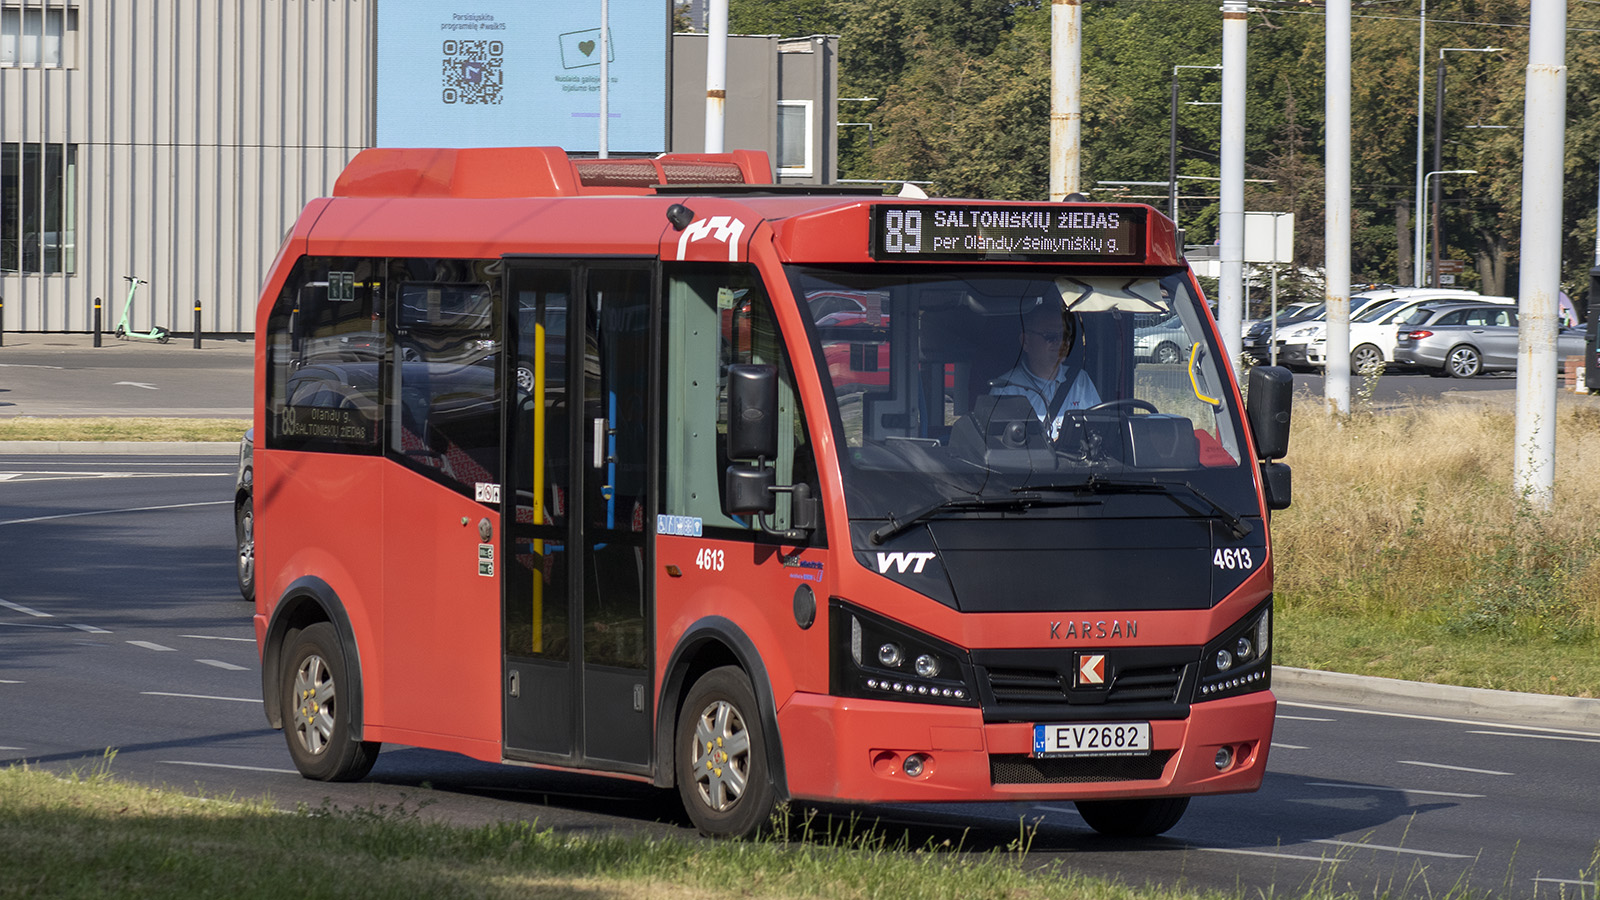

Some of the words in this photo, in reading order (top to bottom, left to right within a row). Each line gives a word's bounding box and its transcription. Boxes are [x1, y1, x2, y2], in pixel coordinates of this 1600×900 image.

[885, 209, 922, 253] 89
[1058, 212, 1120, 229] ŽIEDAS
[934, 236, 960, 251] per
[1107, 238, 1119, 253] g.
[282, 406, 296, 436] 89
[311, 408, 340, 422] Olandų
[343, 411, 351, 423] g.
[696, 548, 725, 571] 4613
[1213, 548, 1253, 570] 4613
[1050, 620, 1138, 639] KARSAN
[1056, 726, 1139, 749] EV2682
